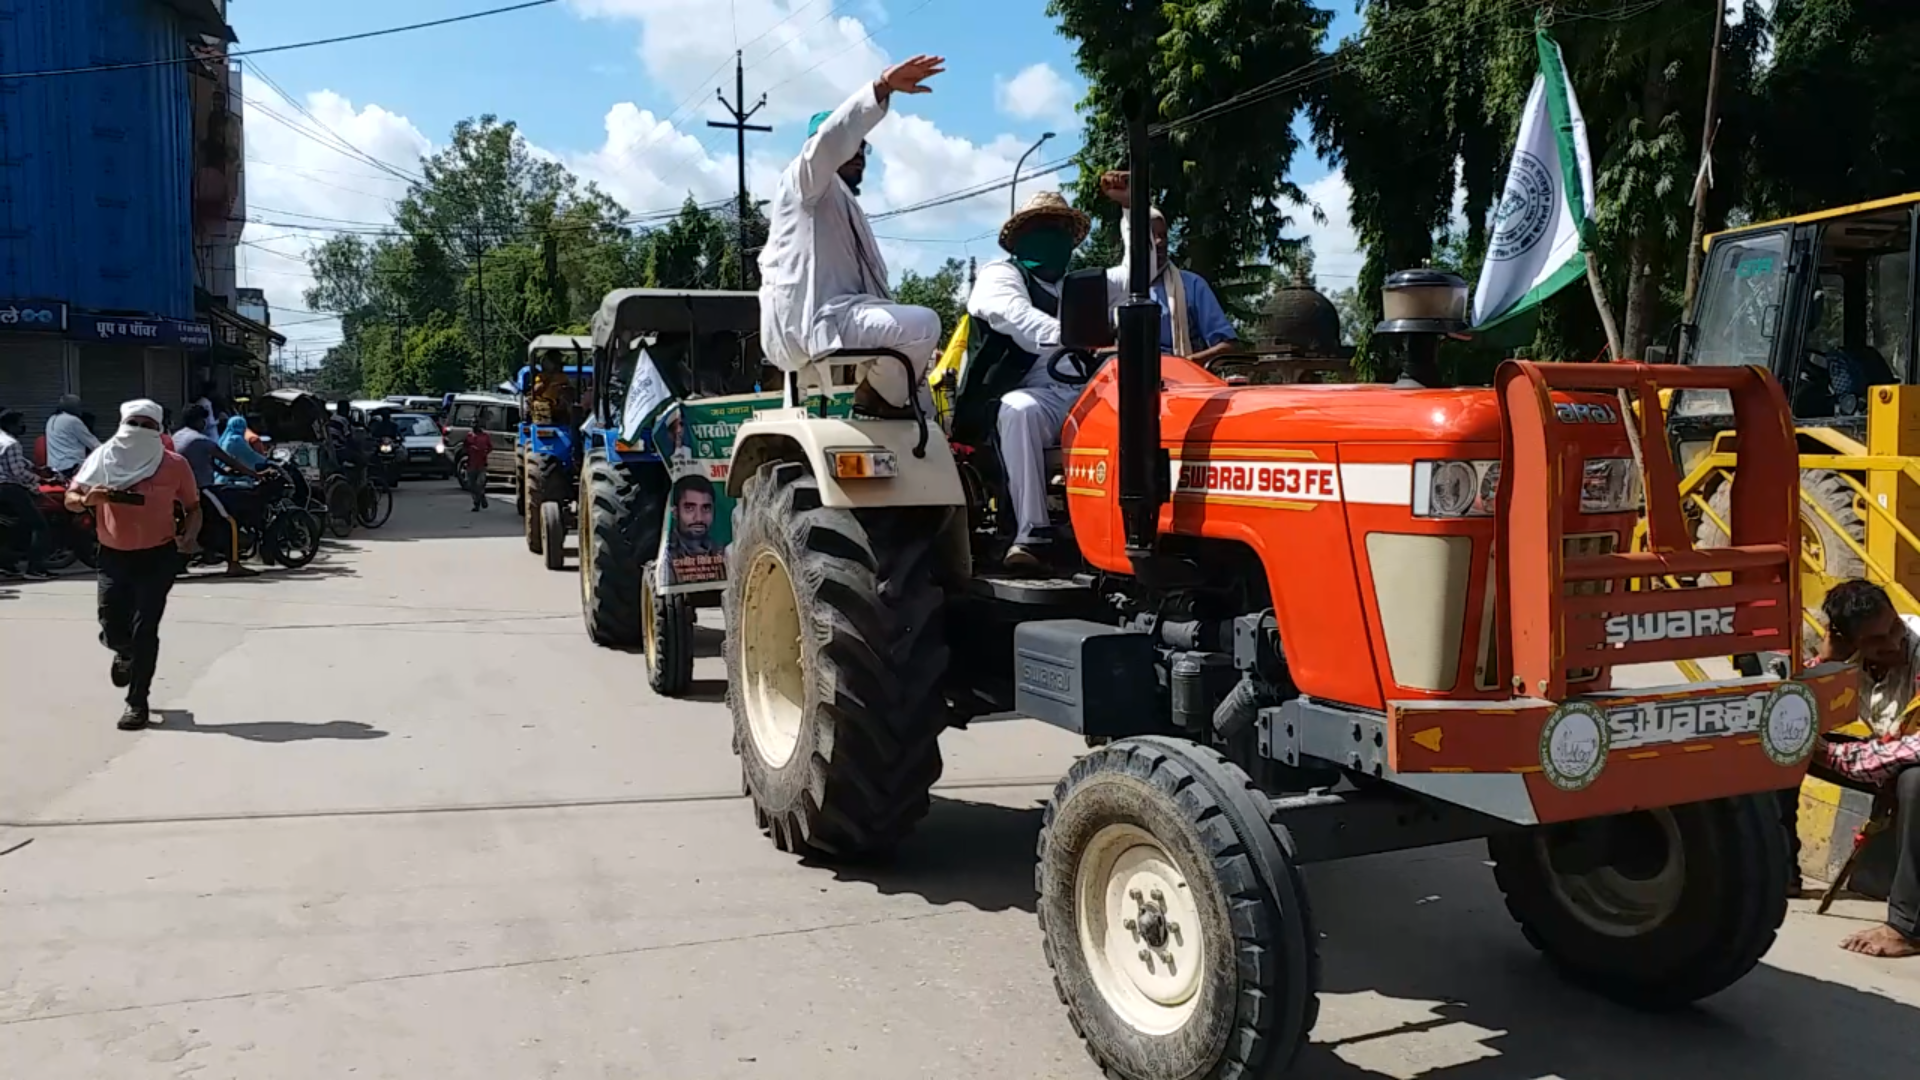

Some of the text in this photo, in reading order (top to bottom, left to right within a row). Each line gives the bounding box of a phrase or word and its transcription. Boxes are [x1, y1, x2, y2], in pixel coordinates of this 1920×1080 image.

[0, 305, 19, 324] ले
[1258, 467, 1301, 494] 963
[1304, 468, 1334, 496] FE
